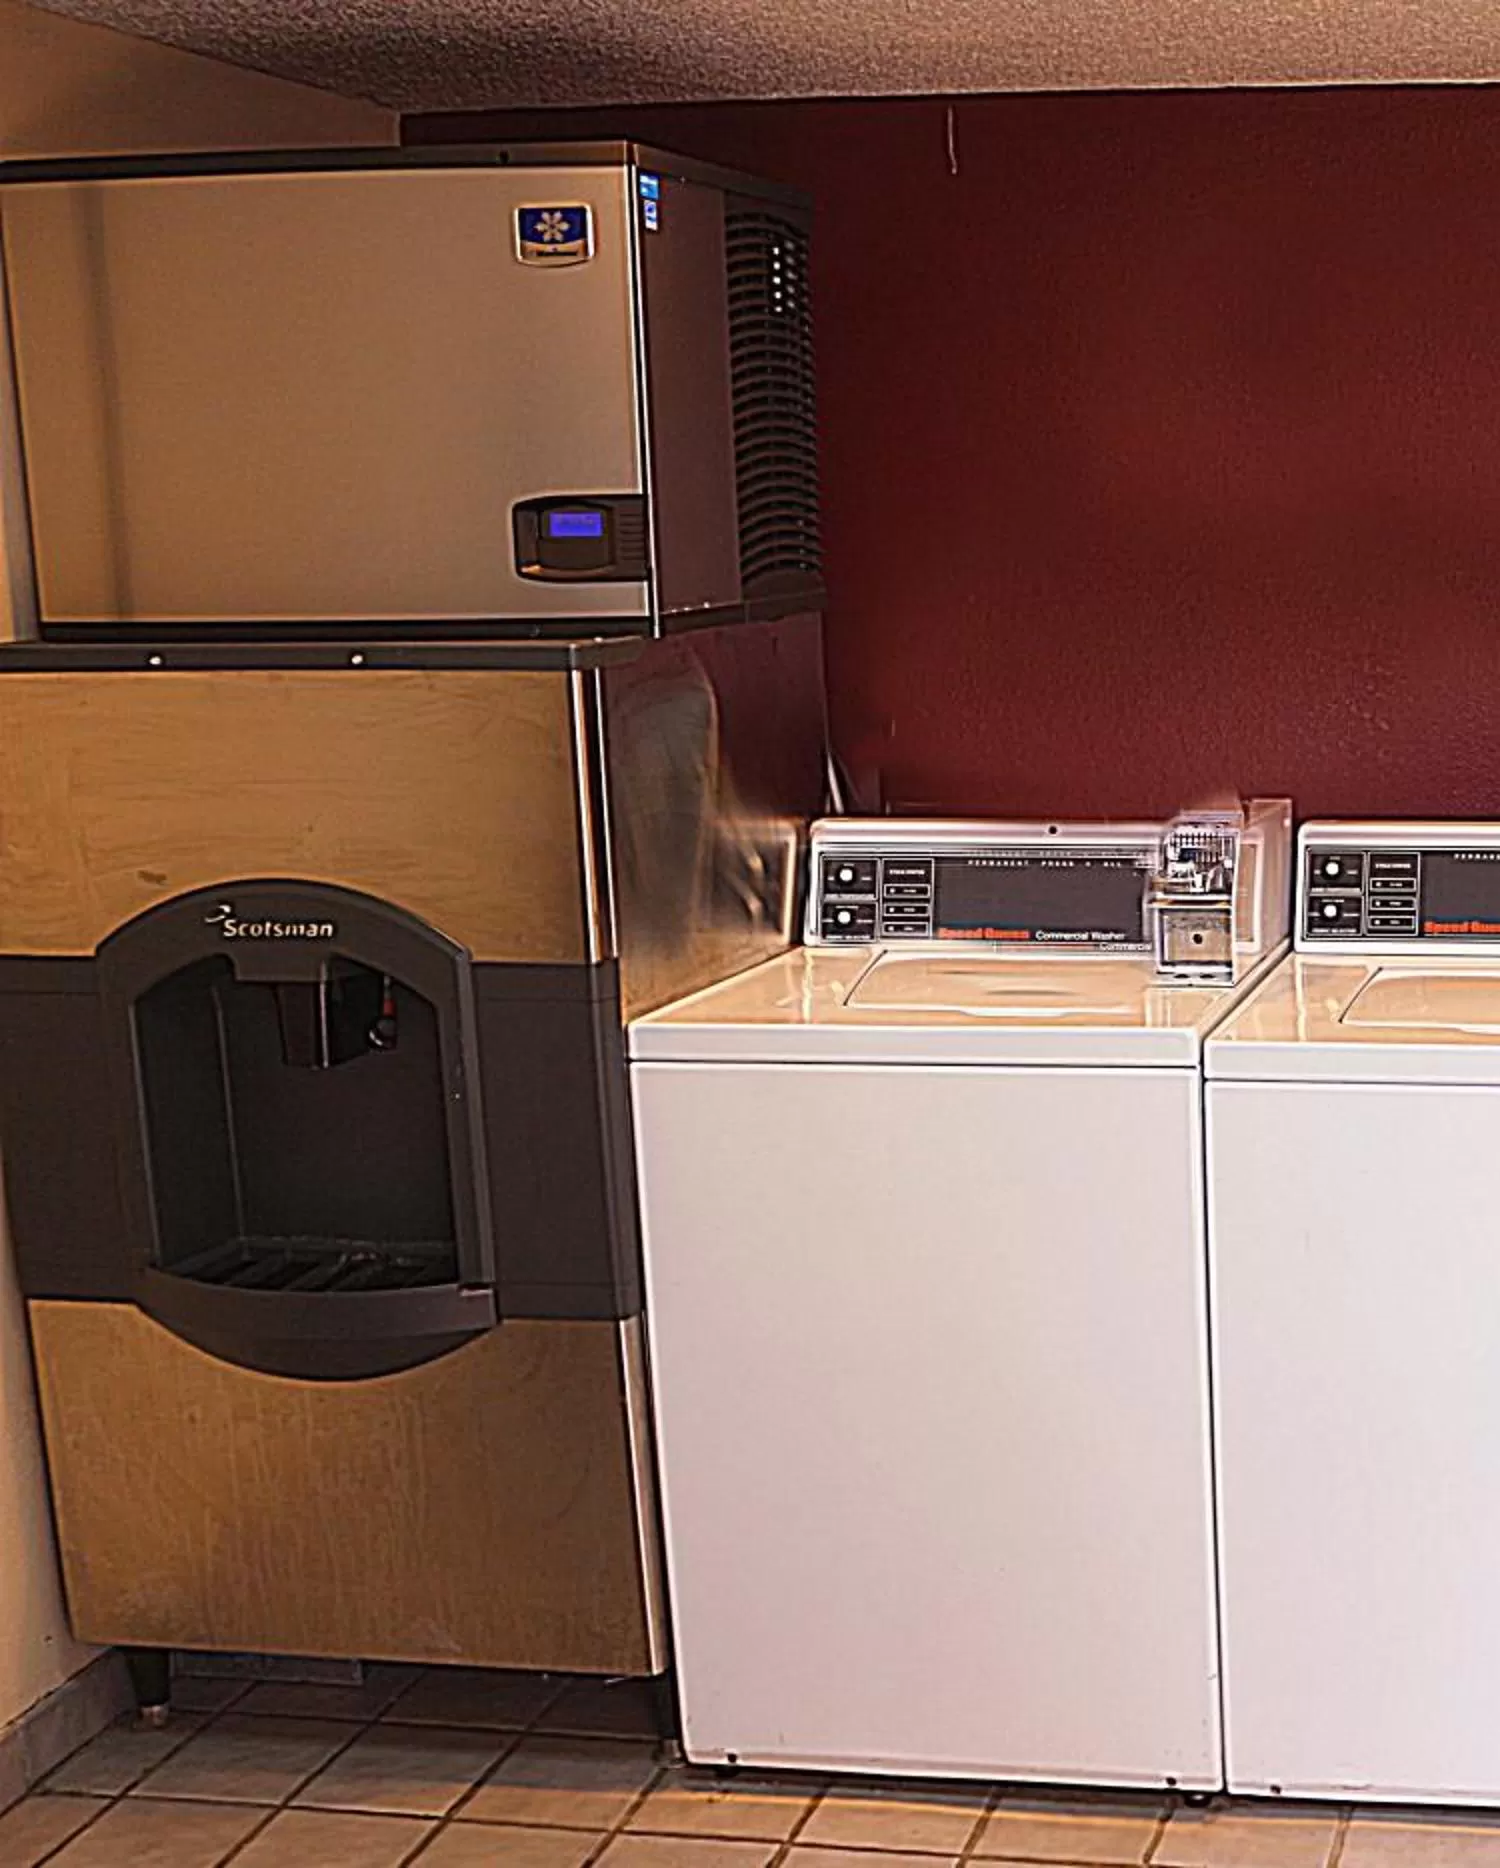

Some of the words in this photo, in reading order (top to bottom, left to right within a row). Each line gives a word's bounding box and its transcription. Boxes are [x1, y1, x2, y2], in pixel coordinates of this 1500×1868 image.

[222, 919, 334, 938] Scotsman
[1035, 930, 1089, 941] Commercial
[1091, 931, 1126, 941] Washer
